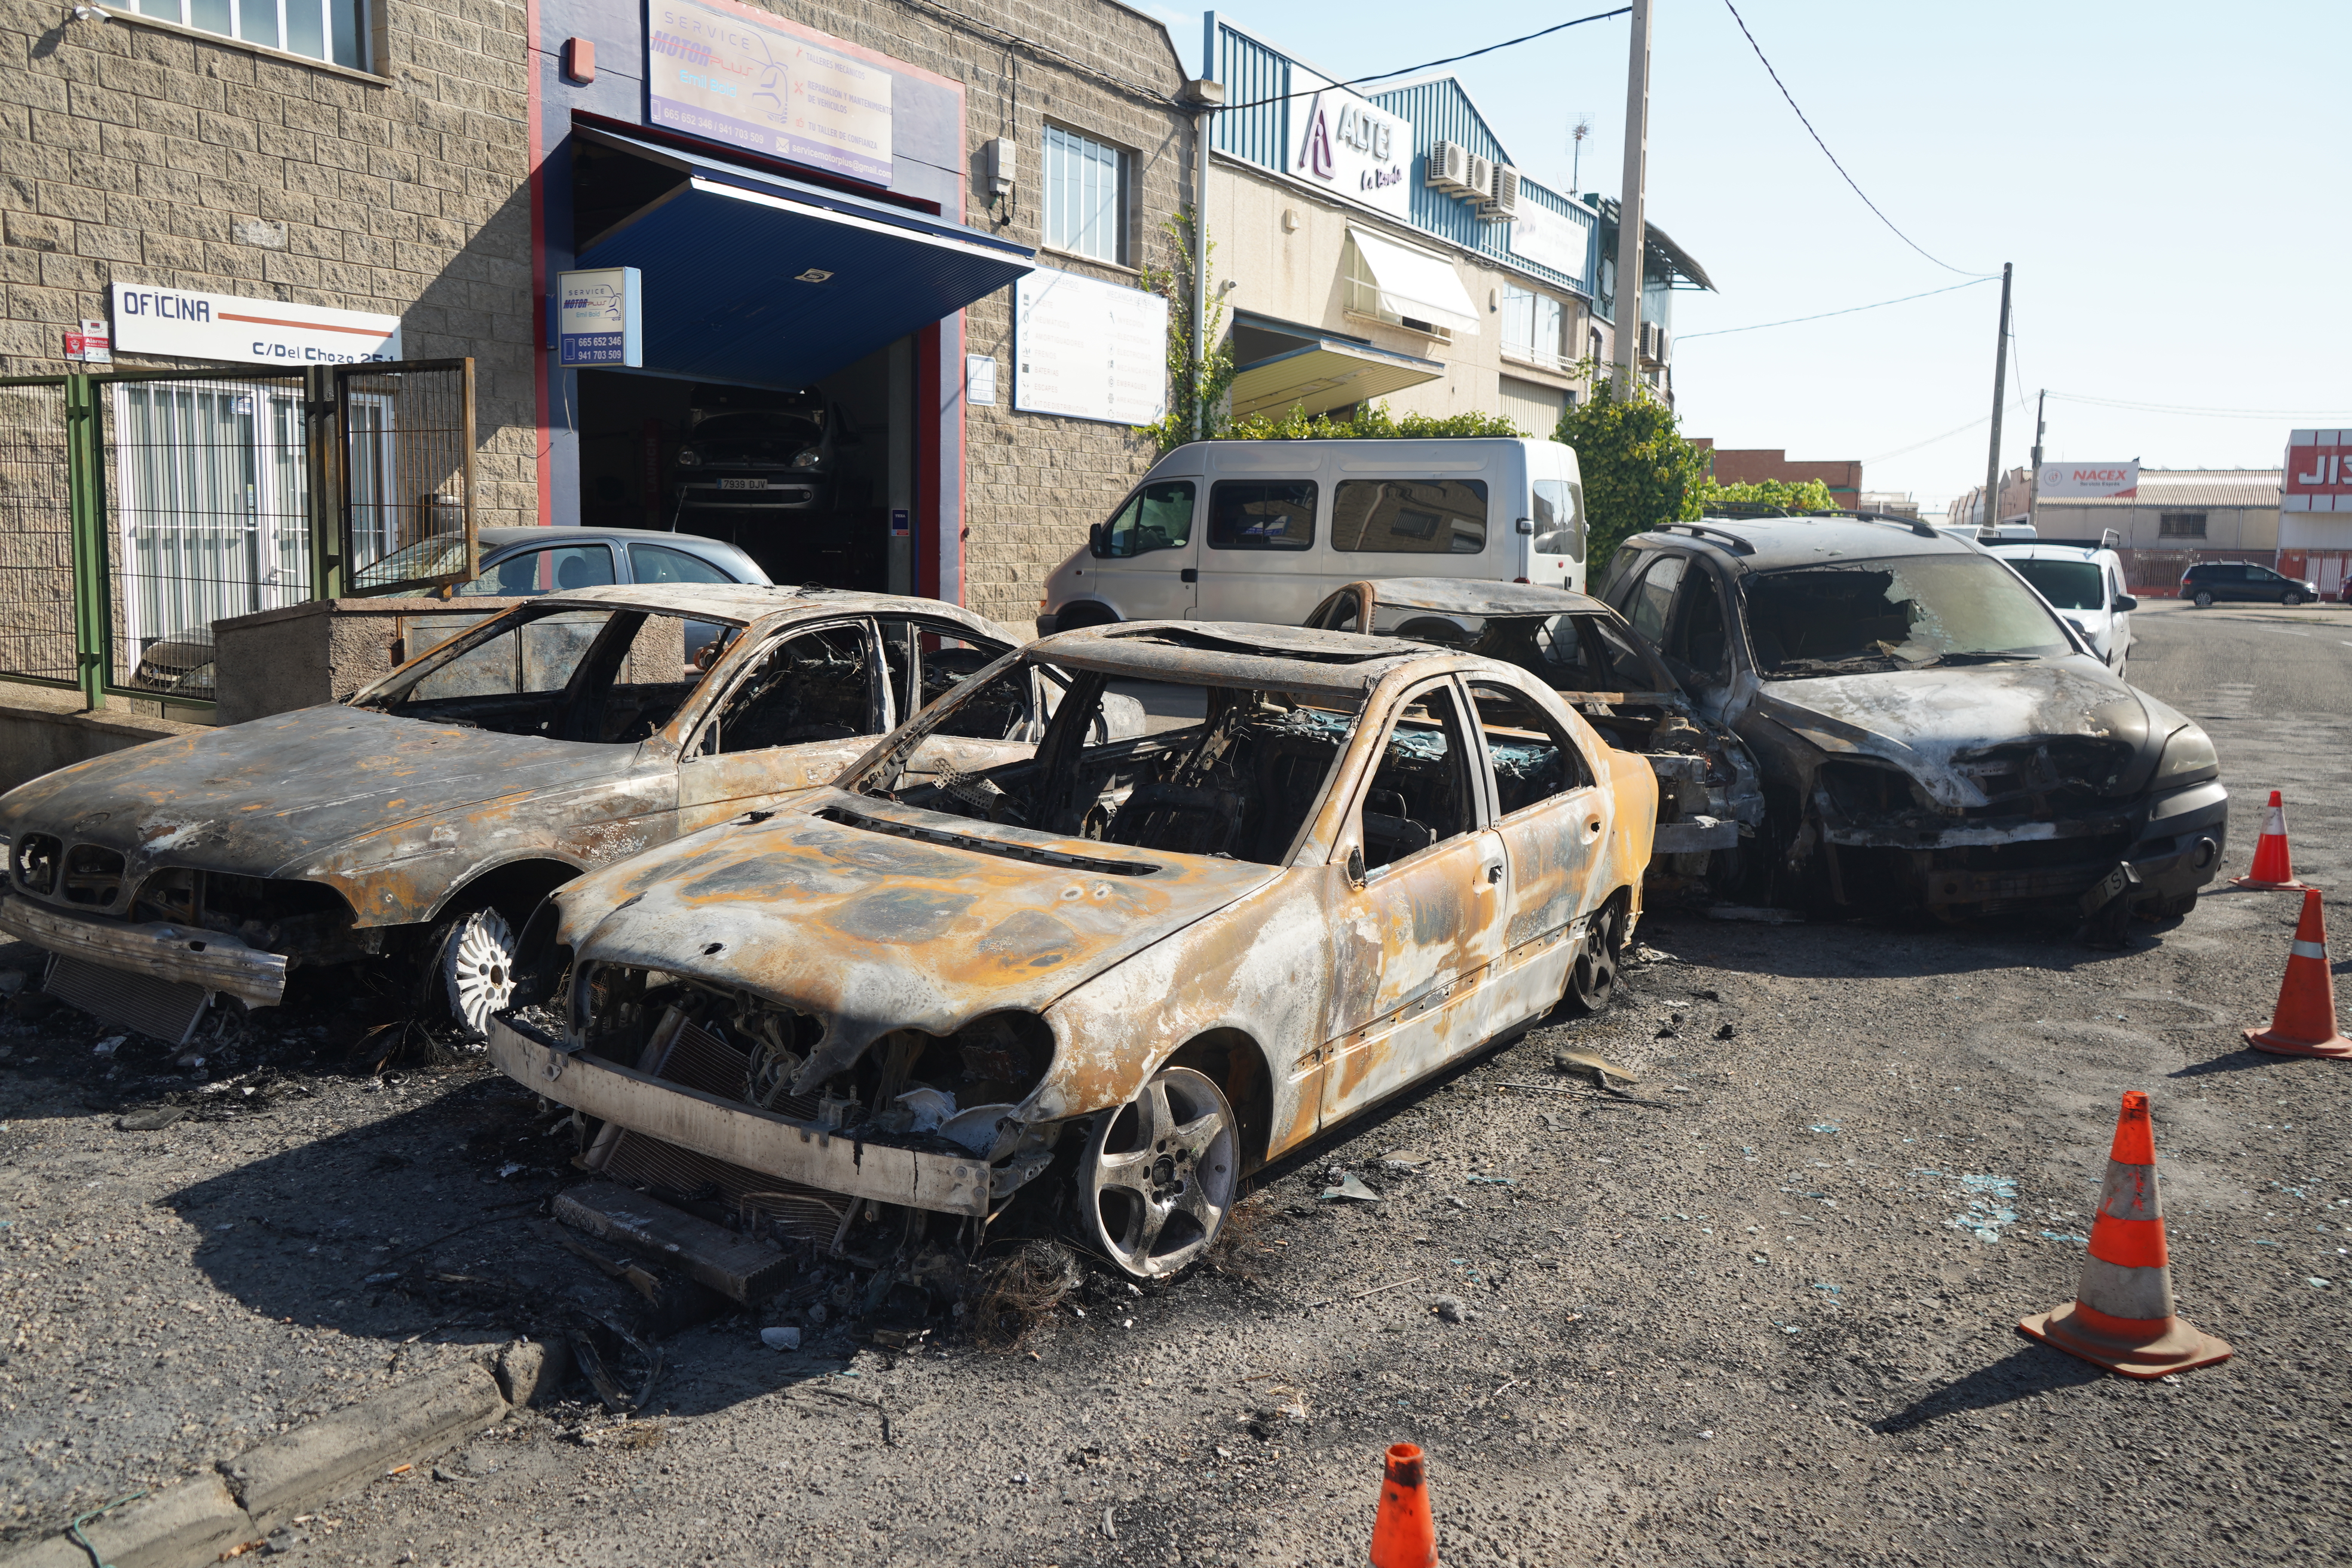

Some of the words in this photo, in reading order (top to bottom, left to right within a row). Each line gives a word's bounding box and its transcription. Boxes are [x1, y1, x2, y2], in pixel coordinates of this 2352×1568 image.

[664, 11, 749, 50] SERVICE
[806, 53, 833, 69] TALLERES
[835, 63, 865, 80] MECÁNICOS
[679, 69, 707, 89] Emil
[710, 78, 737, 97] Bold
[808, 80, 842, 99] REPARACIÓN
[849, 94, 893, 115] MANTENIMIENTO
[808, 94, 816, 104] DE
[817, 97, 847, 114] VEHÍCULOS
[664, 108, 679, 121] 665
[682, 112, 696, 125] 652
[698, 117, 713, 130] 346
[719, 123, 733, 136] 941
[734, 127, 748, 140] 703
[750, 131, 764, 144] 509
[808, 121, 816, 131] TU
[817, 124, 838, 138] TALLER
[839, 131, 846, 140] DE
[848, 133, 878, 150] CONFIANZA
[792, 144, 892, 179] servicemotorplus@gmail.com
[1030, 272, 1056, 284] SERVICIO
[124, 292, 209, 323] OFICINA
[1036, 299, 1053, 308] ACEITE
[1134, 296, 1157, 308] GENERAL
[578, 338, 592, 347] 665
[593, 337, 607, 346] 652
[608, 336, 621, 345] 346
[1035, 333, 1084, 348] AMORTIGUADORES
[578, 351, 591, 360] 941
[593, 351, 607, 360] 703
[608, 350, 621, 359] 509
[1035, 349, 1056, 359] FRENOS
[1117, 348, 1152, 361] ELECTRICIDAD
[1034, 383, 1058, 393] ESCAPES
[1117, 379, 1147, 391] EMBRAGUES
[1116, 411, 1142, 421] DIAGNOSIS
[647, 438, 657, 492] LAUNCH
[2073, 469, 2128, 481] NACEX
[724, 480, 745, 488] 7939
[749, 480, 765, 488] DJV
[148, 701, 158, 718] FFJ
